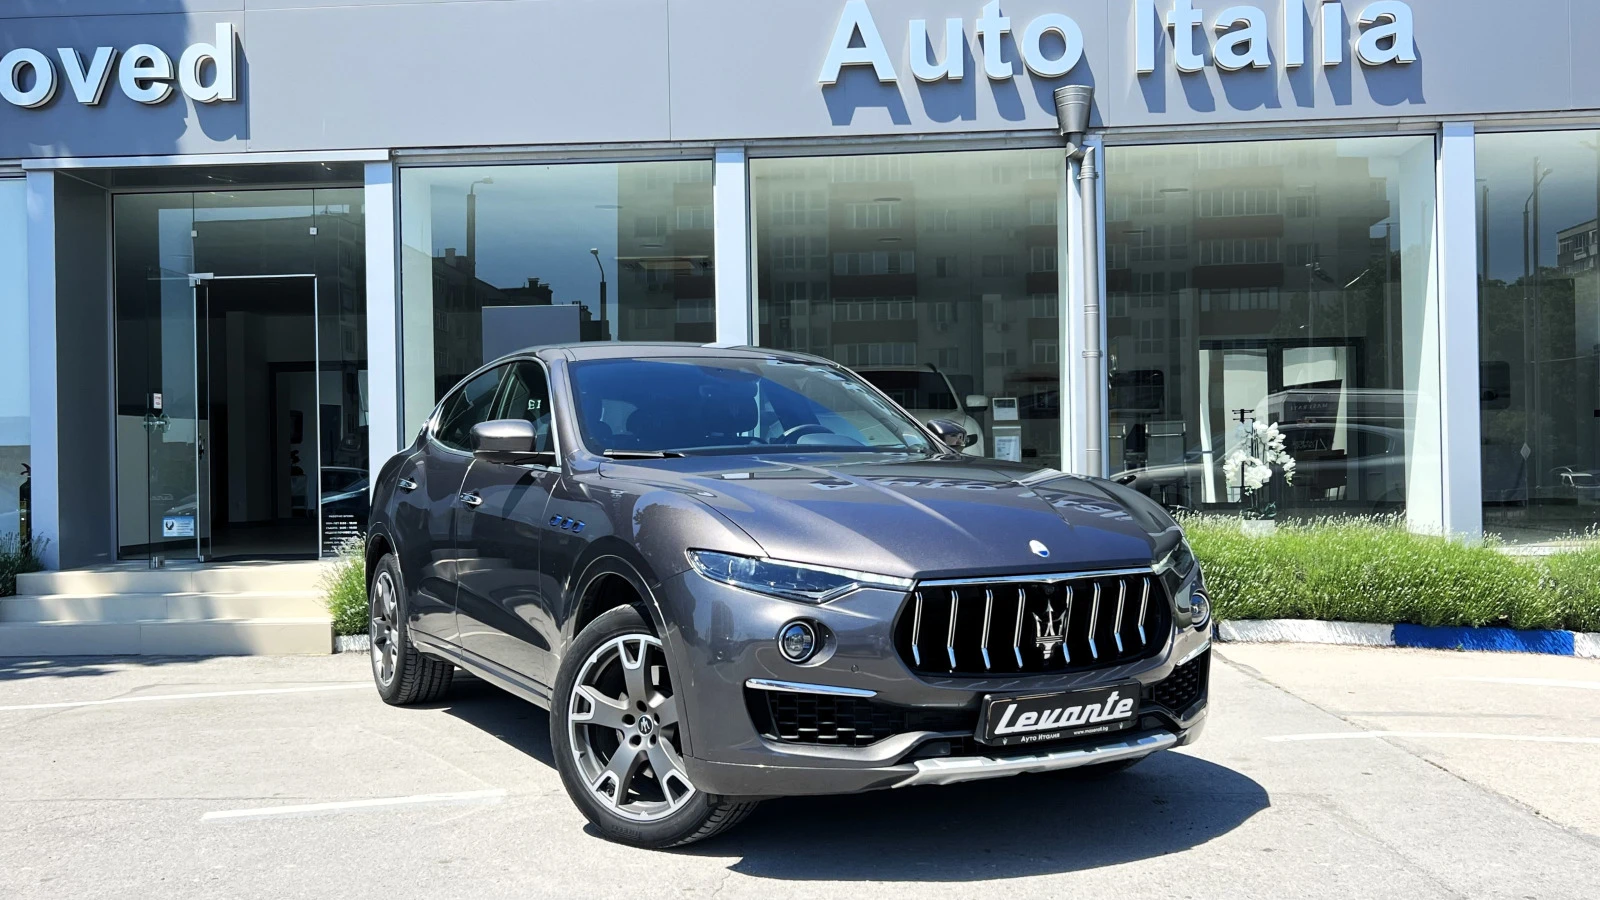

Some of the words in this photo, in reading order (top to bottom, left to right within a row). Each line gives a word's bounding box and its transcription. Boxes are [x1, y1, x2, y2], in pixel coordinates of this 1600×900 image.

[0, 22, 237, 108] oved
[818, 0, 1084, 84] Auto
[1134, 0, 1417, 73] Italia
[994, 690, 1134, 735] Levante
